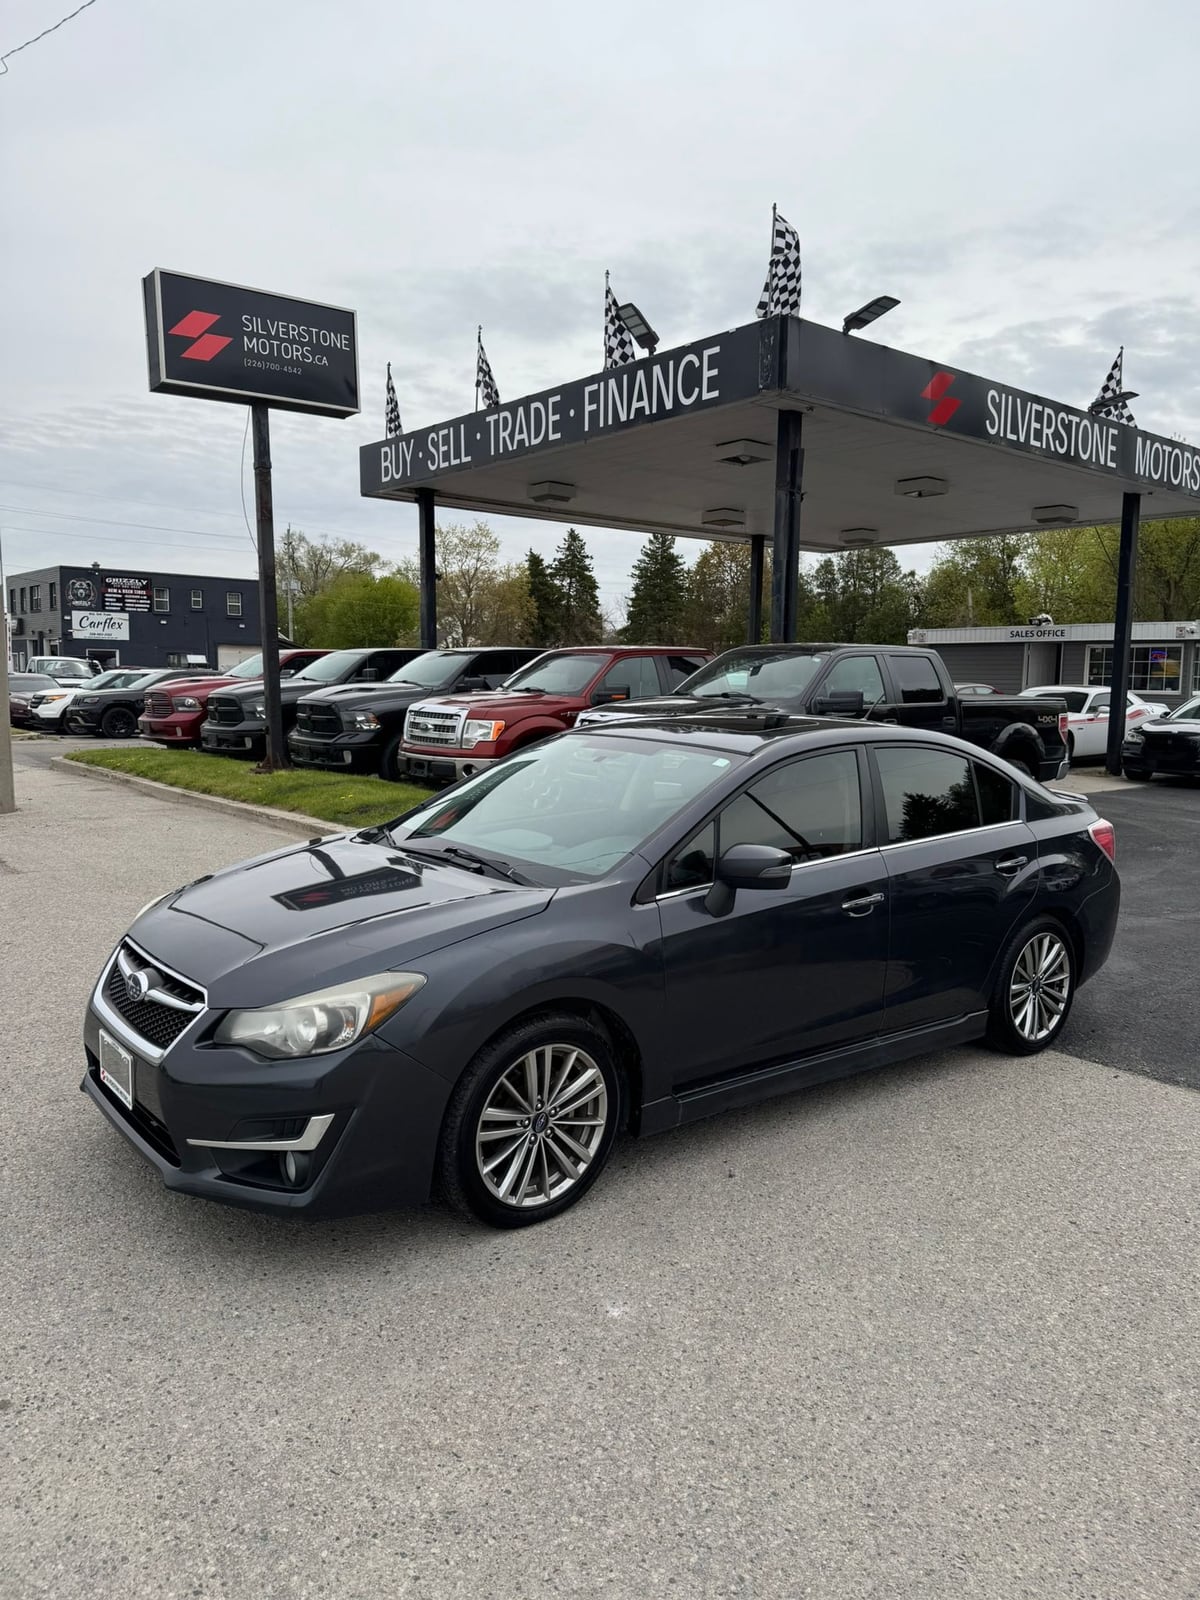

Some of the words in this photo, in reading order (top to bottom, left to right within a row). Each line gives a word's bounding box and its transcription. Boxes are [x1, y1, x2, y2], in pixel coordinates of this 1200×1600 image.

[242, 315, 350, 351] SILVERSTONE
[243, 335, 329, 367] MOTORS.CA
[244, 358, 302, 375] (226)700-4542
[380, 438, 414, 483] BUY
[427, 424, 472, 471] SELL
[486, 394, 562, 456] TRADE
[584, 345, 721, 432] FINANCE
[985, 388, 1119, 469] SILVERSTONE
[1134, 436, 1200, 491] MOTORS
[79, 615, 123, 632] Carflex
[1010, 630, 1035, 638] SALES
[1036, 629, 1066, 638] OFFICE
